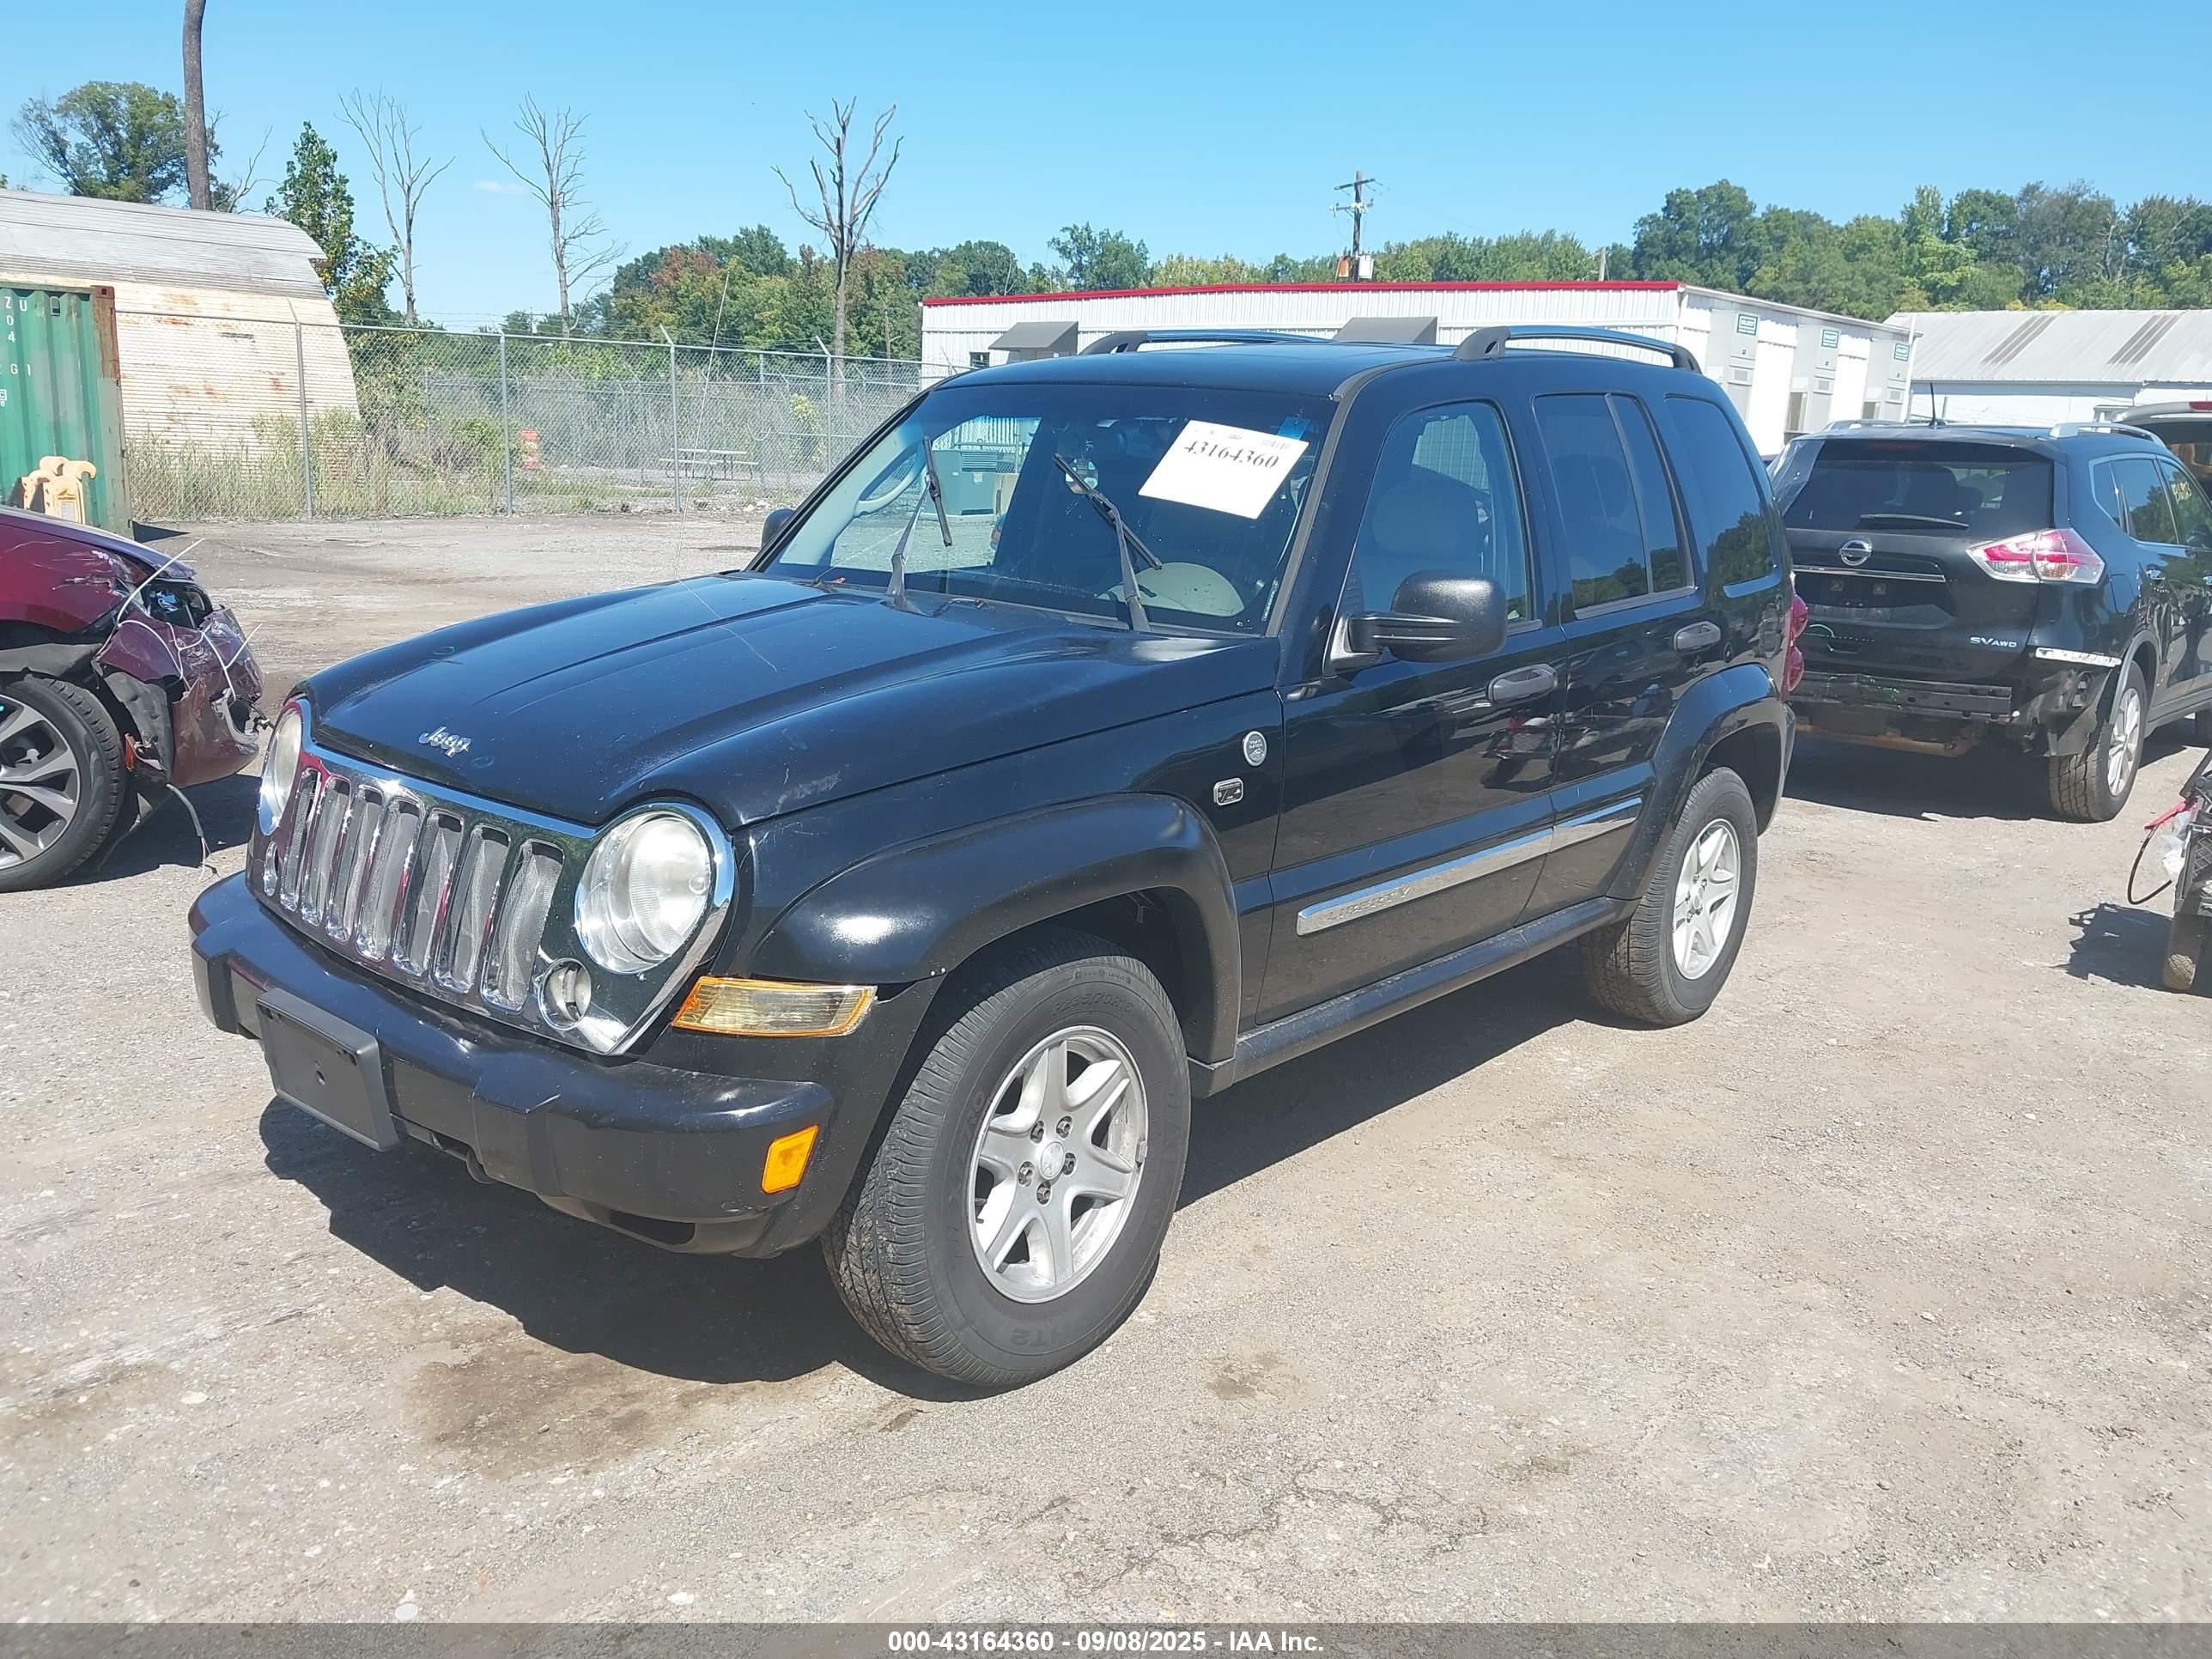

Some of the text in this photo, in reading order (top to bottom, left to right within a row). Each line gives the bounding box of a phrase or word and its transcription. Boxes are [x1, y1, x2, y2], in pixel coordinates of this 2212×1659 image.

[1184, 440, 1279, 469] 43164360
[1970, 636, 1993, 645] SV
[418, 726, 471, 758] Jeep
